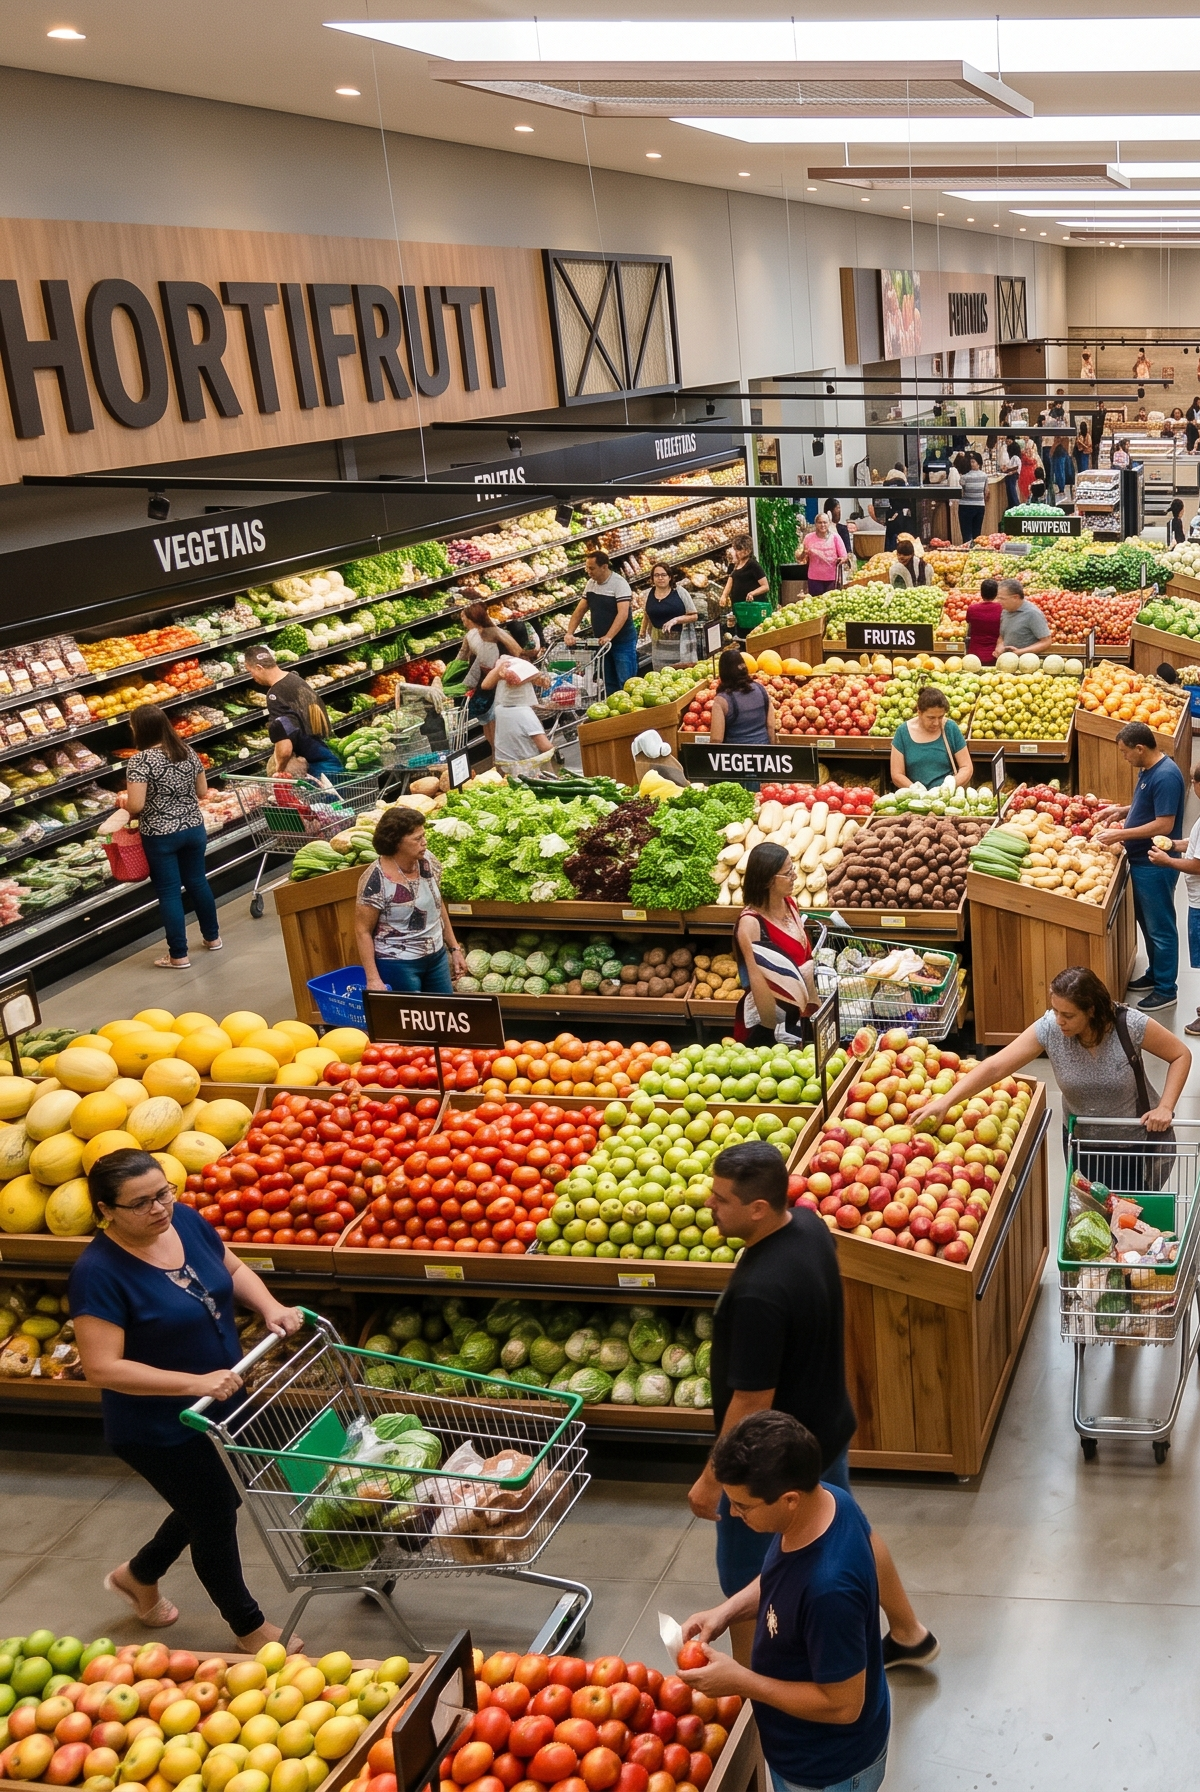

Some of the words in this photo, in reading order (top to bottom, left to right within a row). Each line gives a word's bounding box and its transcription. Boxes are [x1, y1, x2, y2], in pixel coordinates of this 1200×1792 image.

[0, 278, 507, 439] HORTIFRUTI
[153, 519, 266, 573] VEGETAIS
[863, 629, 916, 646] FRUTAS
[707, 753, 794, 774] VEGETAIS
[400, 1008, 471, 1034] FRUTAS
